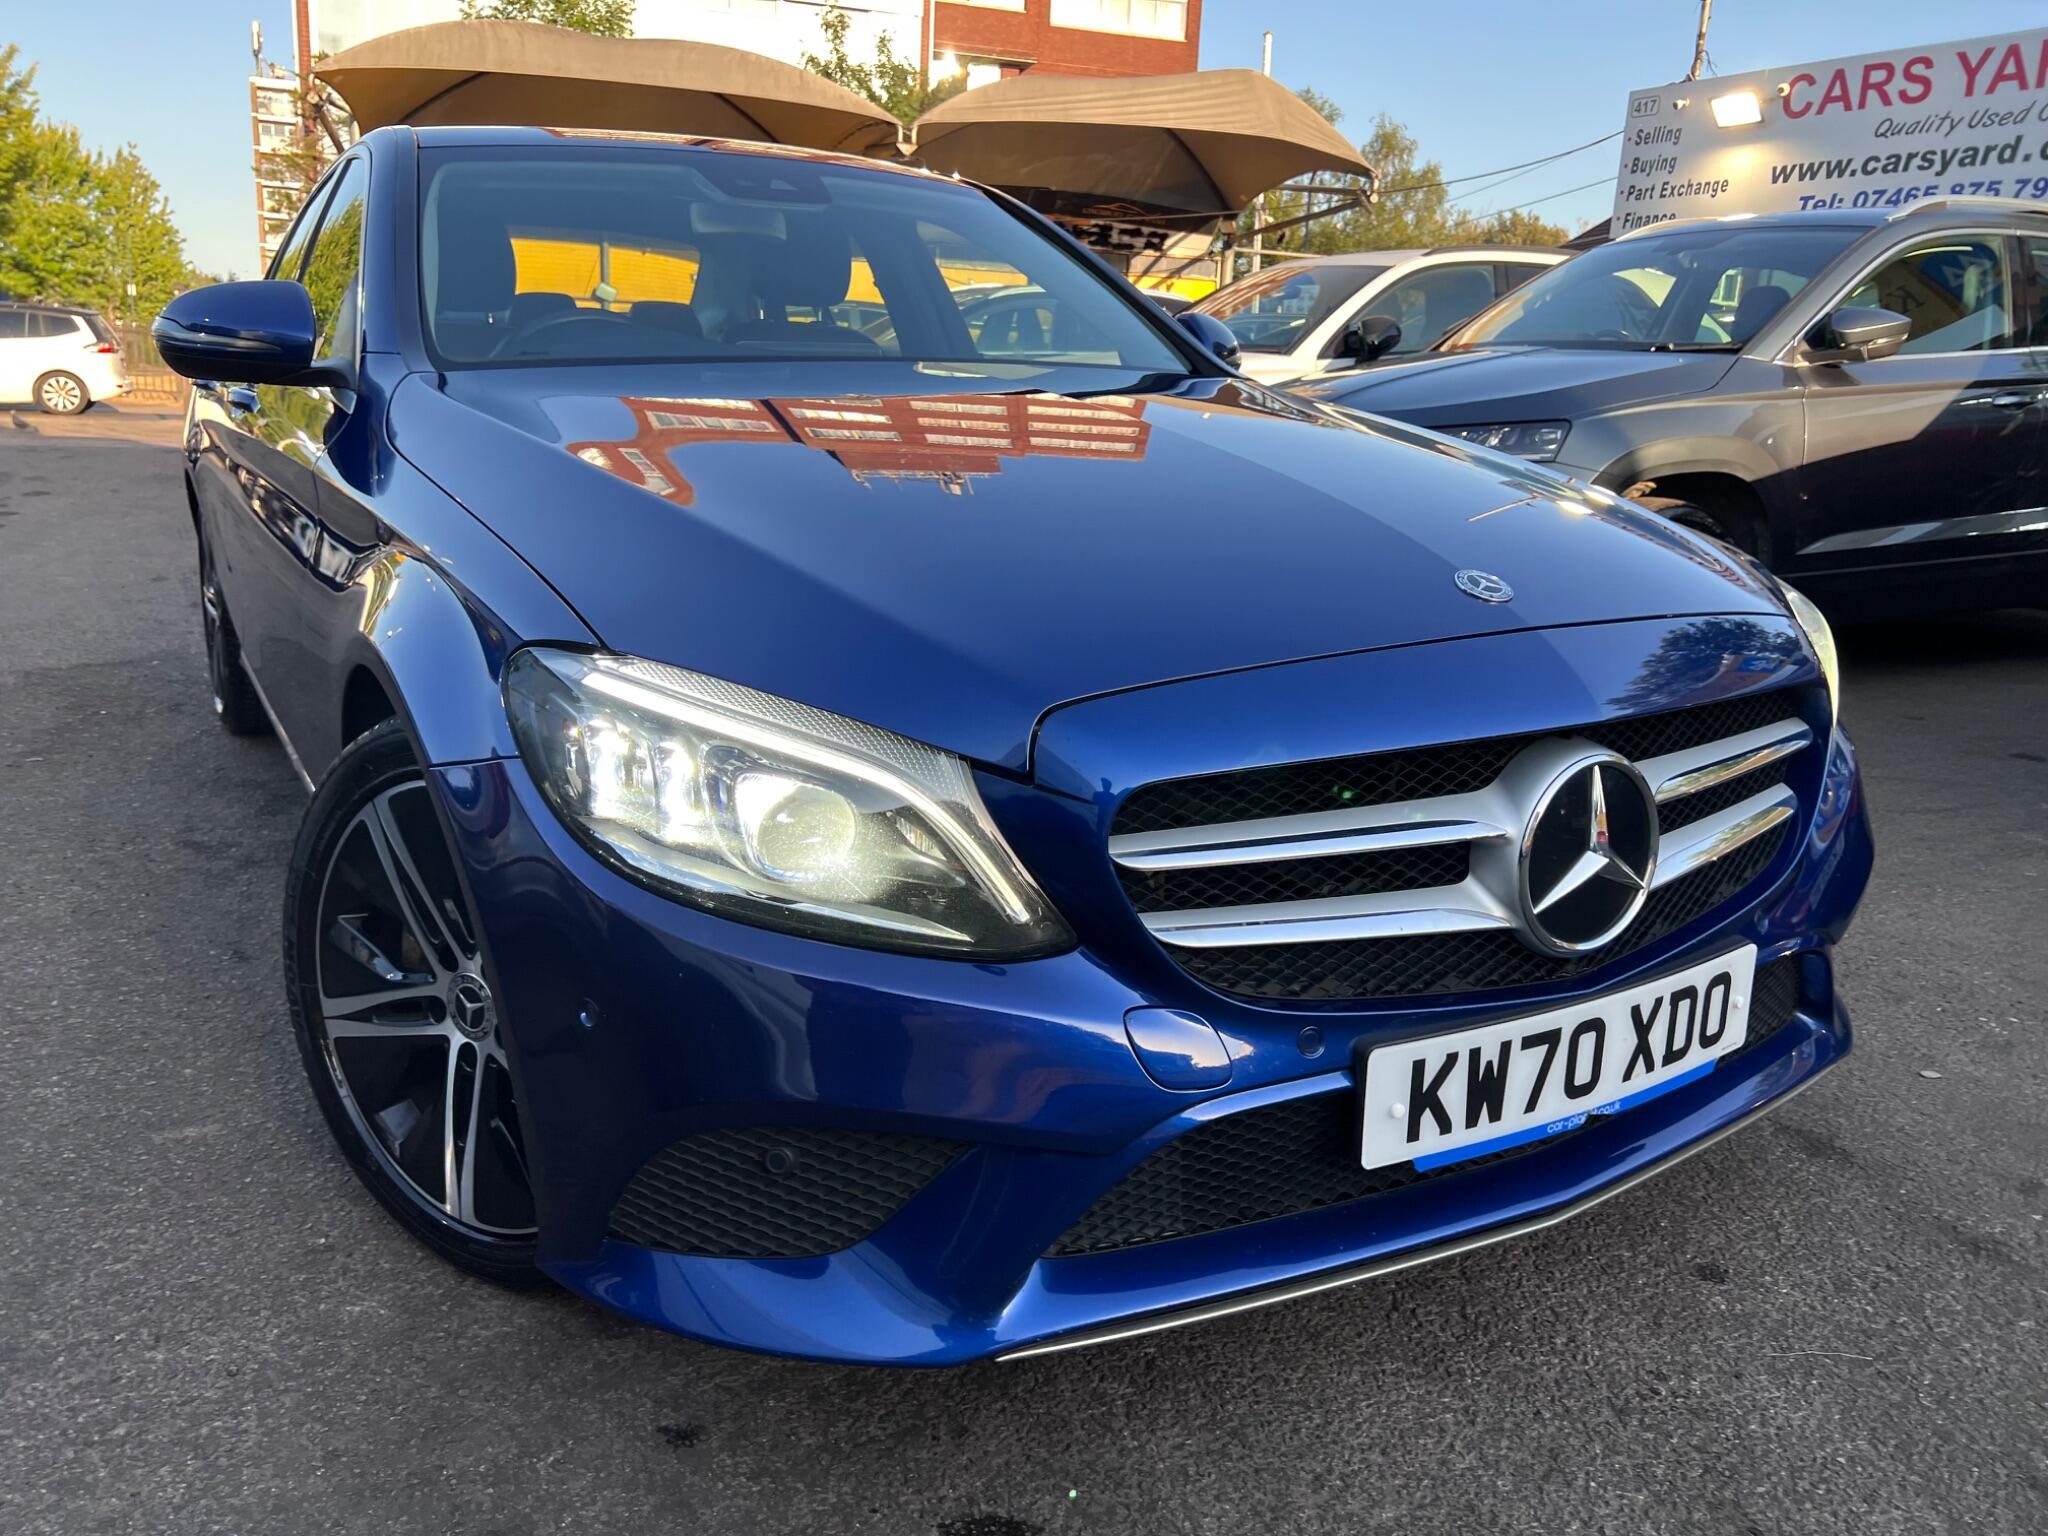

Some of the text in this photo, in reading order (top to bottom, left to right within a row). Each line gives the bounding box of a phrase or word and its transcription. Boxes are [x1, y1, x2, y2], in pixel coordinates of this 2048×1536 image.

[1783, 56, 1934, 119] CARS
[1634, 99, 1658, 114] 417
[1874, 110, 1965, 138] Quality
[1968, 100, 2038, 129] Used
[1634, 125, 1682, 146] Selling
[1630, 154, 1678, 177] Buying
[1626, 179, 1729, 202] Part Exchange
[1799, 192, 1845, 211] Tel:
[1406, 971, 1732, 1143] KW70 XDO
